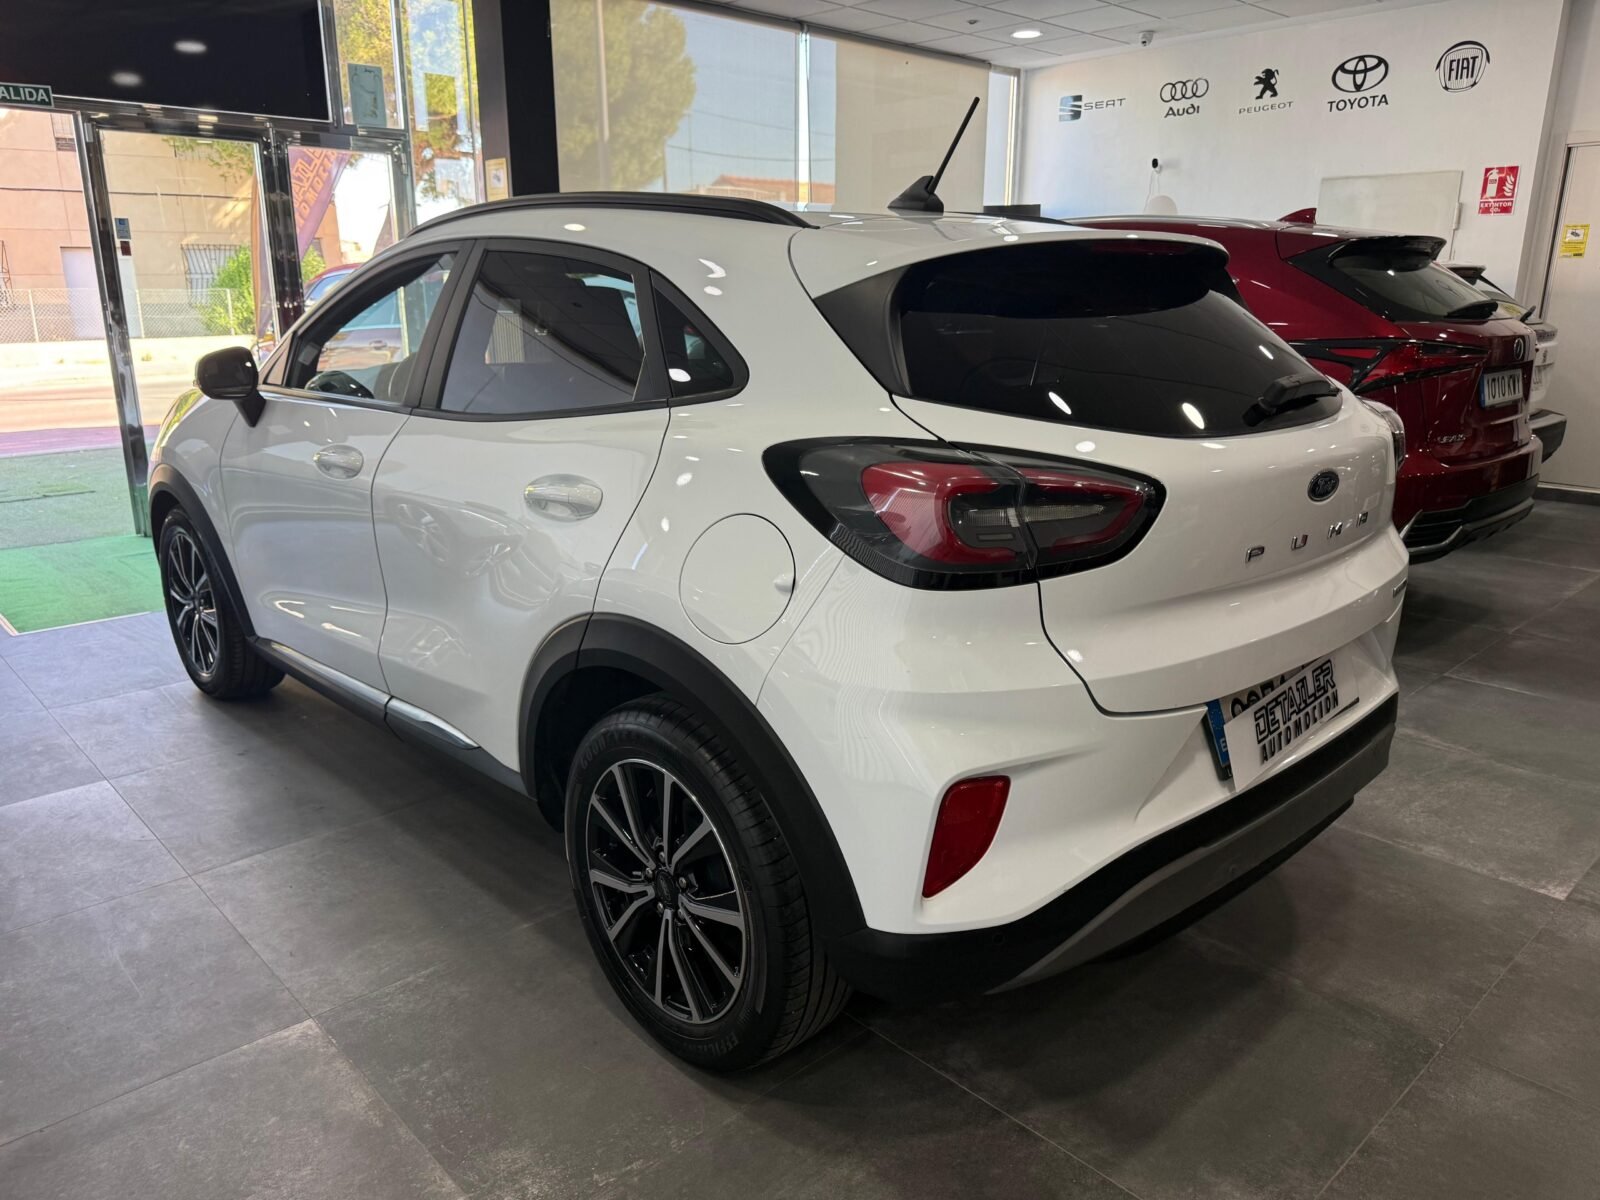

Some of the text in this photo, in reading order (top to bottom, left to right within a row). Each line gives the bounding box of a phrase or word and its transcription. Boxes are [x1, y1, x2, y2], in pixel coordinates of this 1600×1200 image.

[1448, 56, 1479, 82] FIAT
[1083, 98, 1126, 111] SEAT
[1164, 104, 1201, 118] Audi
[1238, 101, 1294, 115] PEUGEOT
[1327, 94, 1389, 112] TOYOTA
[1487, 375, 1506, 401] 1010
[1245, 511, 1369, 563] PUMA
[1254, 659, 1336, 744] DETAILER
[1259, 689, 1339, 765] AUTOMOCION
